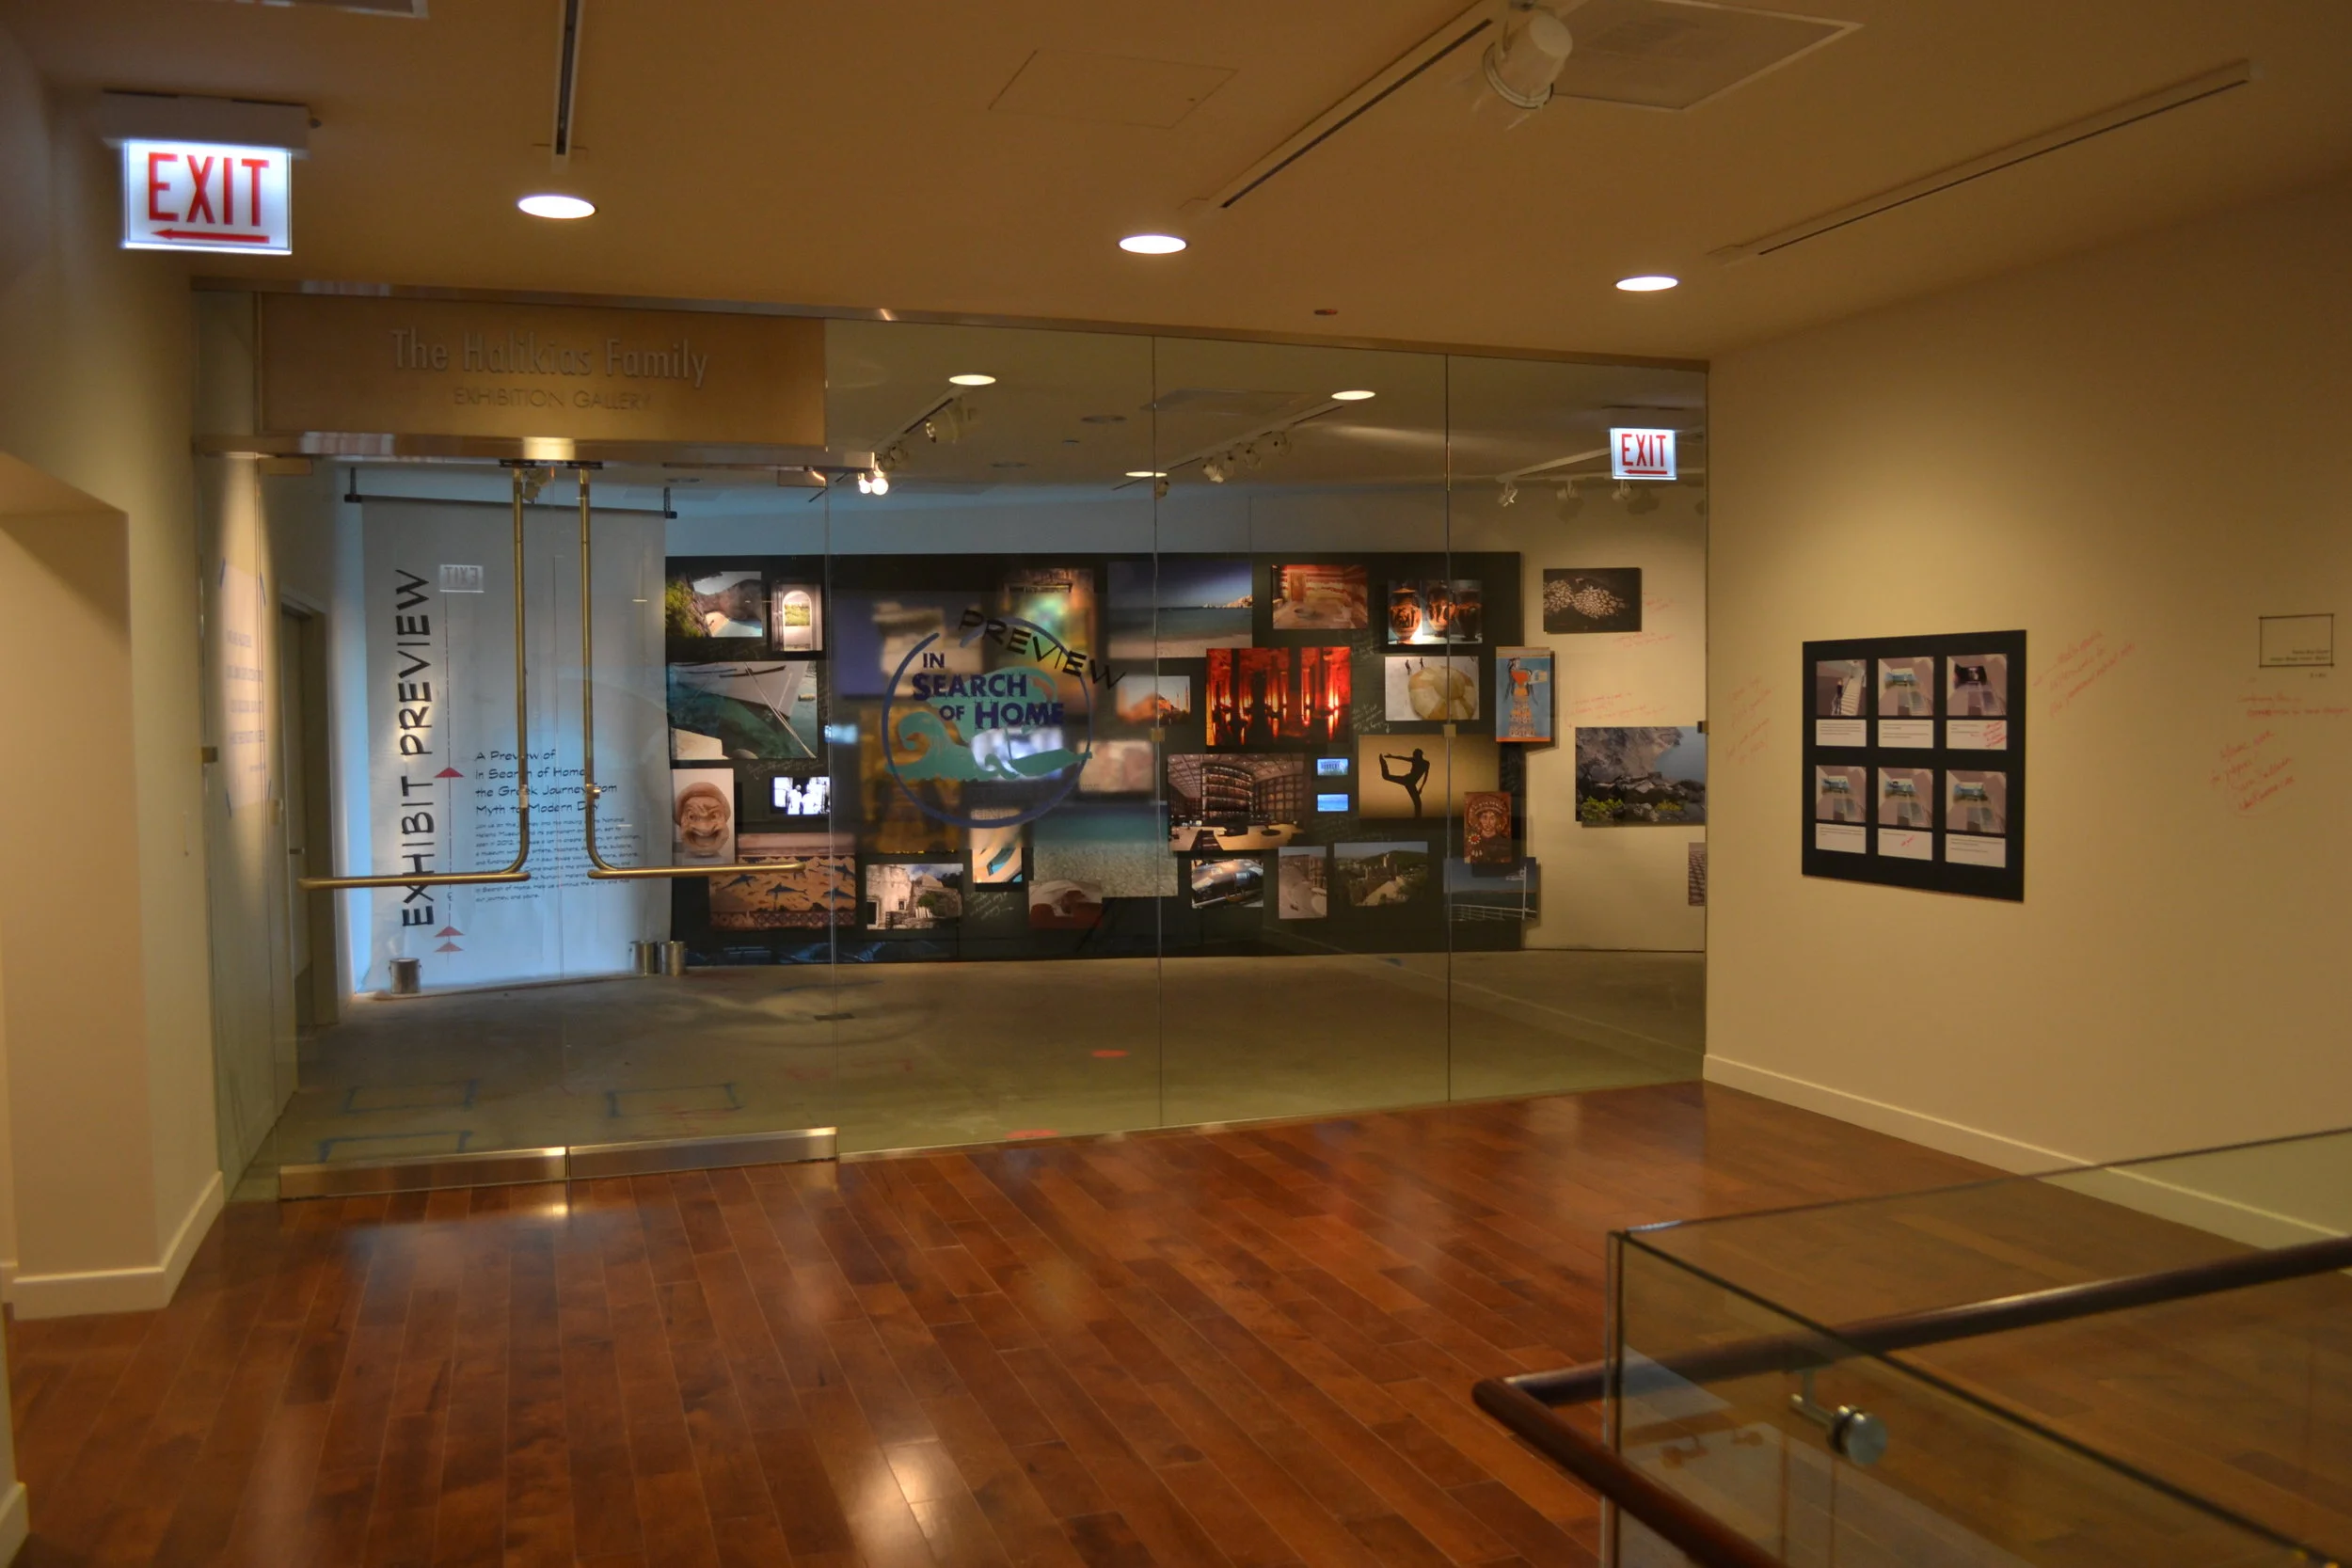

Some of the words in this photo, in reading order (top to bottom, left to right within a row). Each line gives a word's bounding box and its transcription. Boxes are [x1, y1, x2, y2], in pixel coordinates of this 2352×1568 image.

[148, 151, 270, 227] EXIT
[393, 327, 449, 372] The
[463, 330, 592, 376] Halikias
[605, 337, 708, 390] Family
[453, 387, 564, 408] EXHIBITION
[573, 389, 652, 410] GALLERY
[1621, 434, 1667, 467] EXIT
[395, 569, 433, 756] PREVIEW
[923, 652, 945, 669] IN
[958, 609, 1127, 691] PREVIEW
[912, 673, 1027, 701] SEARCH
[939, 705, 964, 721] OF
[975, 702, 1064, 730] HOME
[474, 752, 486, 761] A
[543, 749, 556, 760] of
[537, 767, 550, 778] of
[475, 786, 494, 798] the
[476, 804, 506, 817] Myth
[401, 776, 435, 927] EXHIBIT
